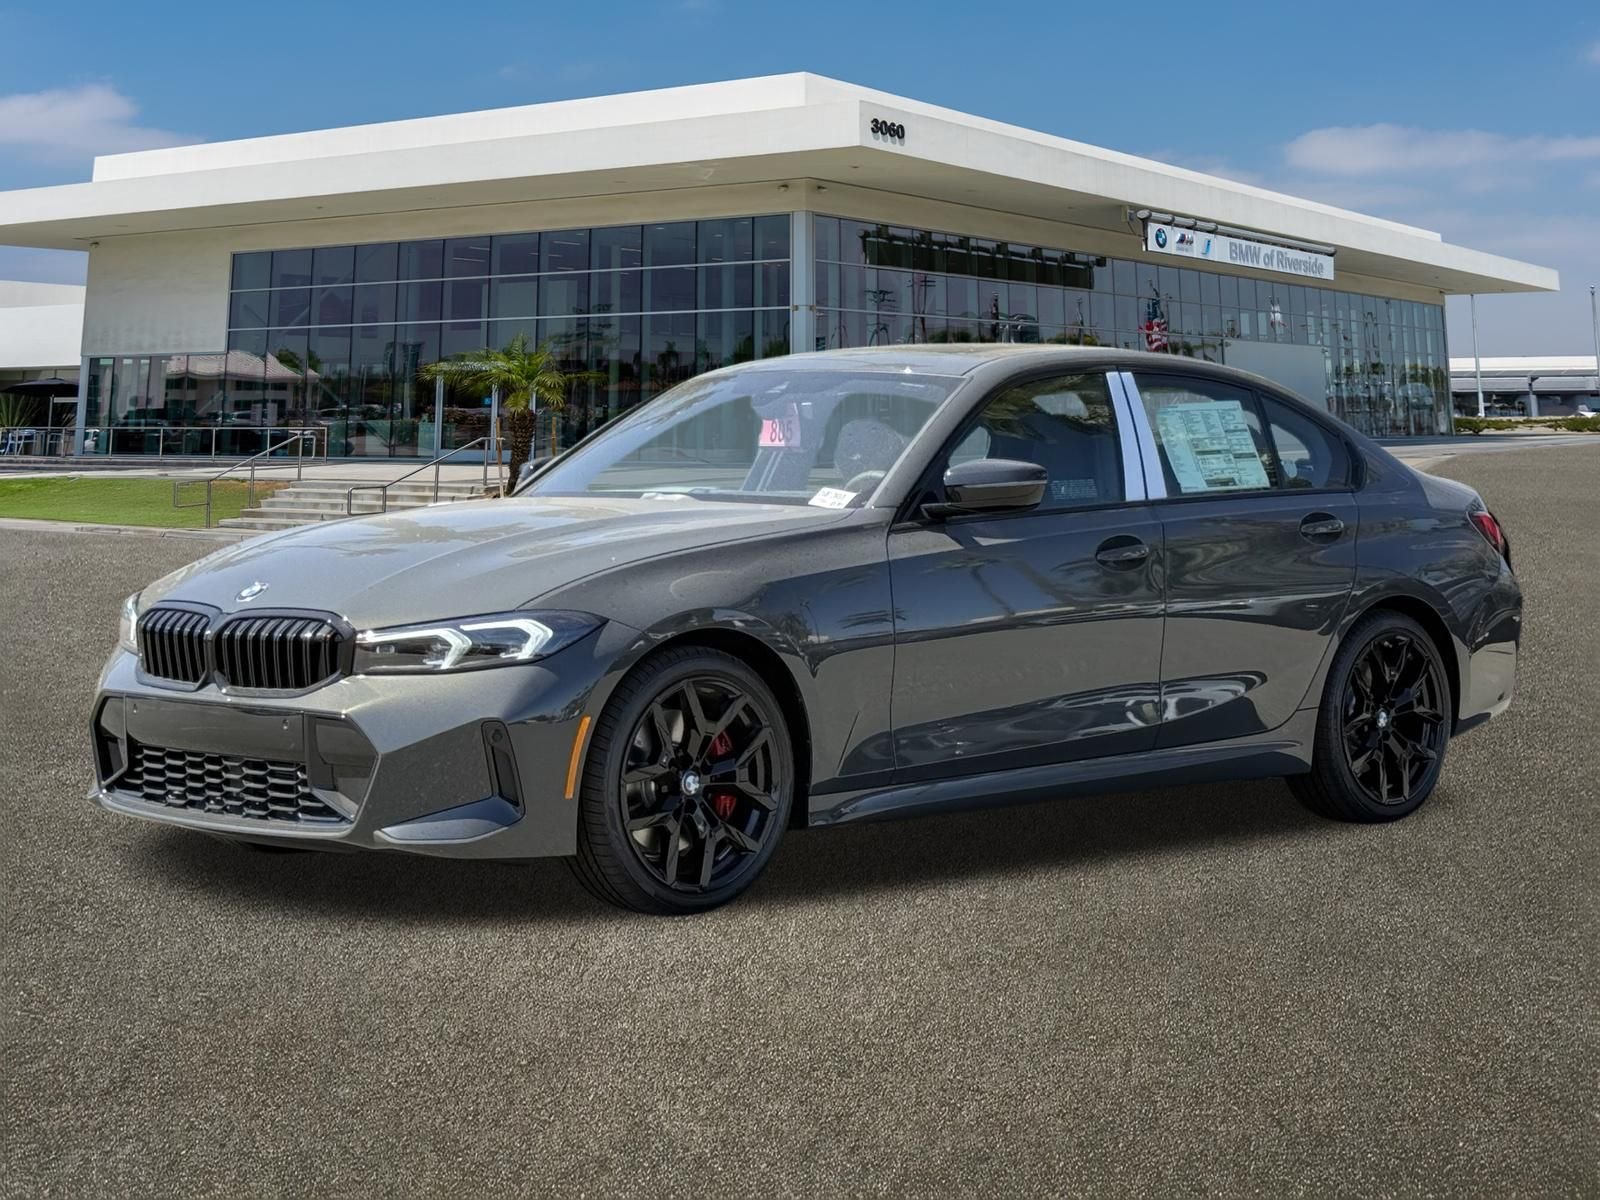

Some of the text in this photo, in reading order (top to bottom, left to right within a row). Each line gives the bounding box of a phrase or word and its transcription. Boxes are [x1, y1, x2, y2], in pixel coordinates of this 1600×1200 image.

[871, 118, 905, 139] 3060
[1229, 241, 1324, 275] BMW of Riverside
